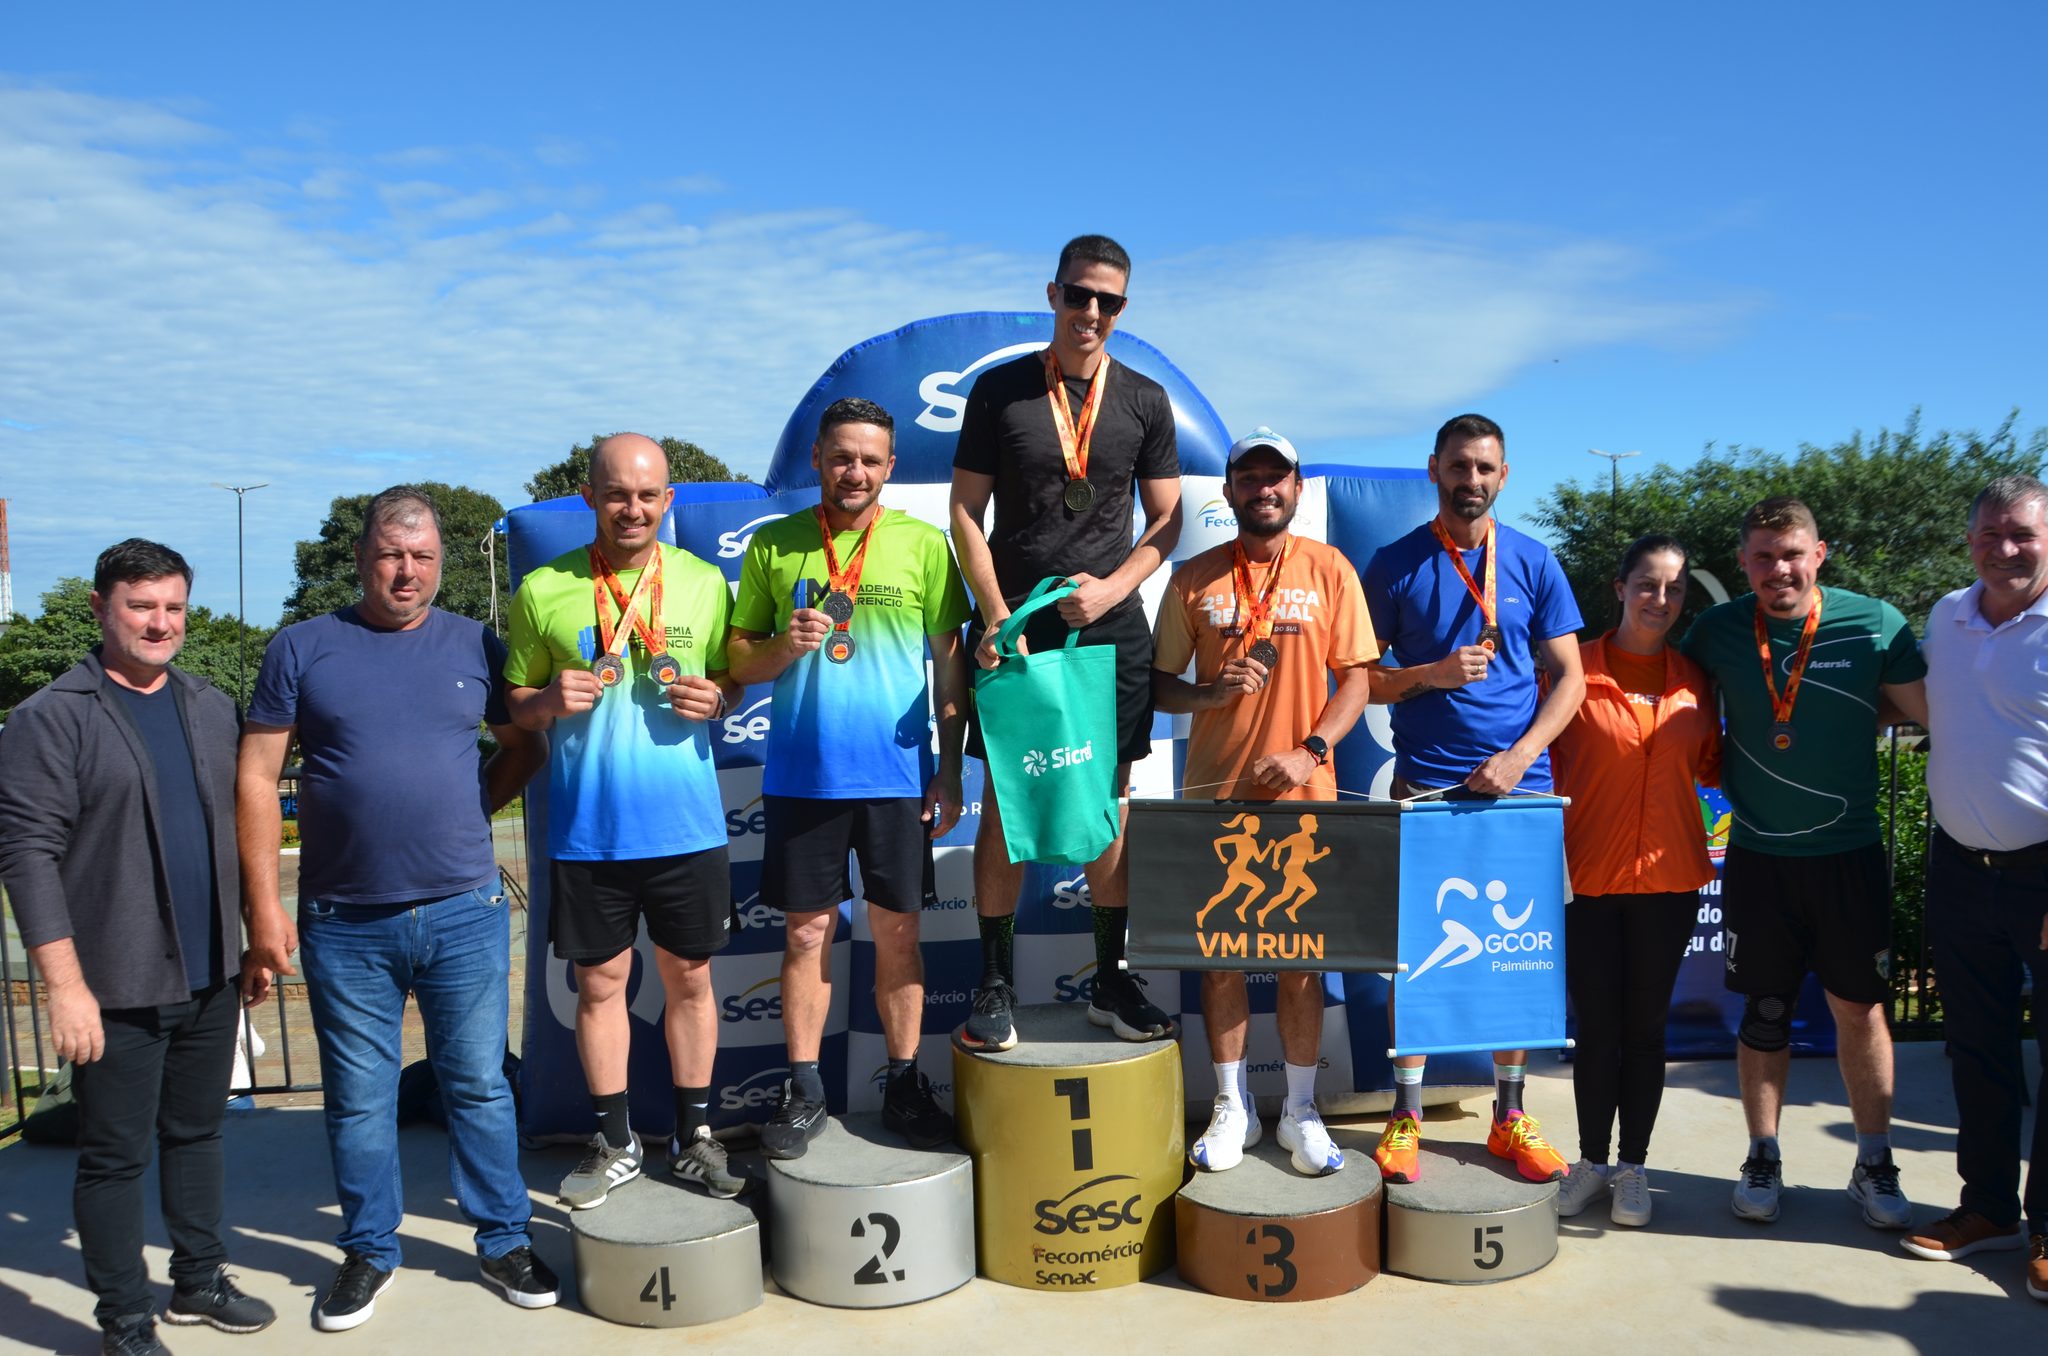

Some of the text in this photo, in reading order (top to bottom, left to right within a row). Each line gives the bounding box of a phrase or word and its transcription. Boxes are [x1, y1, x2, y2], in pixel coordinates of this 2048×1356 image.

[1205, 516, 1239, 527] Feco
[858, 584, 902, 595] ADEMIA
[1196, 932, 1324, 960] VM RUN
[1485, 931, 1553, 954] GCOR
[1492, 960, 1554, 972] Palmitinho
[1054, 1077, 1093, 1171] 1
[1033, 1194, 1142, 1235] Sesc
[851, 1212, 905, 1285] 2
[1033, 1240, 1143, 1265] Fecomércio
[1246, 1224, 1298, 1297] 3
[1473, 1225, 1504, 1270] 5
[640, 1266, 676, 1311] 4
[1036, 1269, 1096, 1286] Senac
